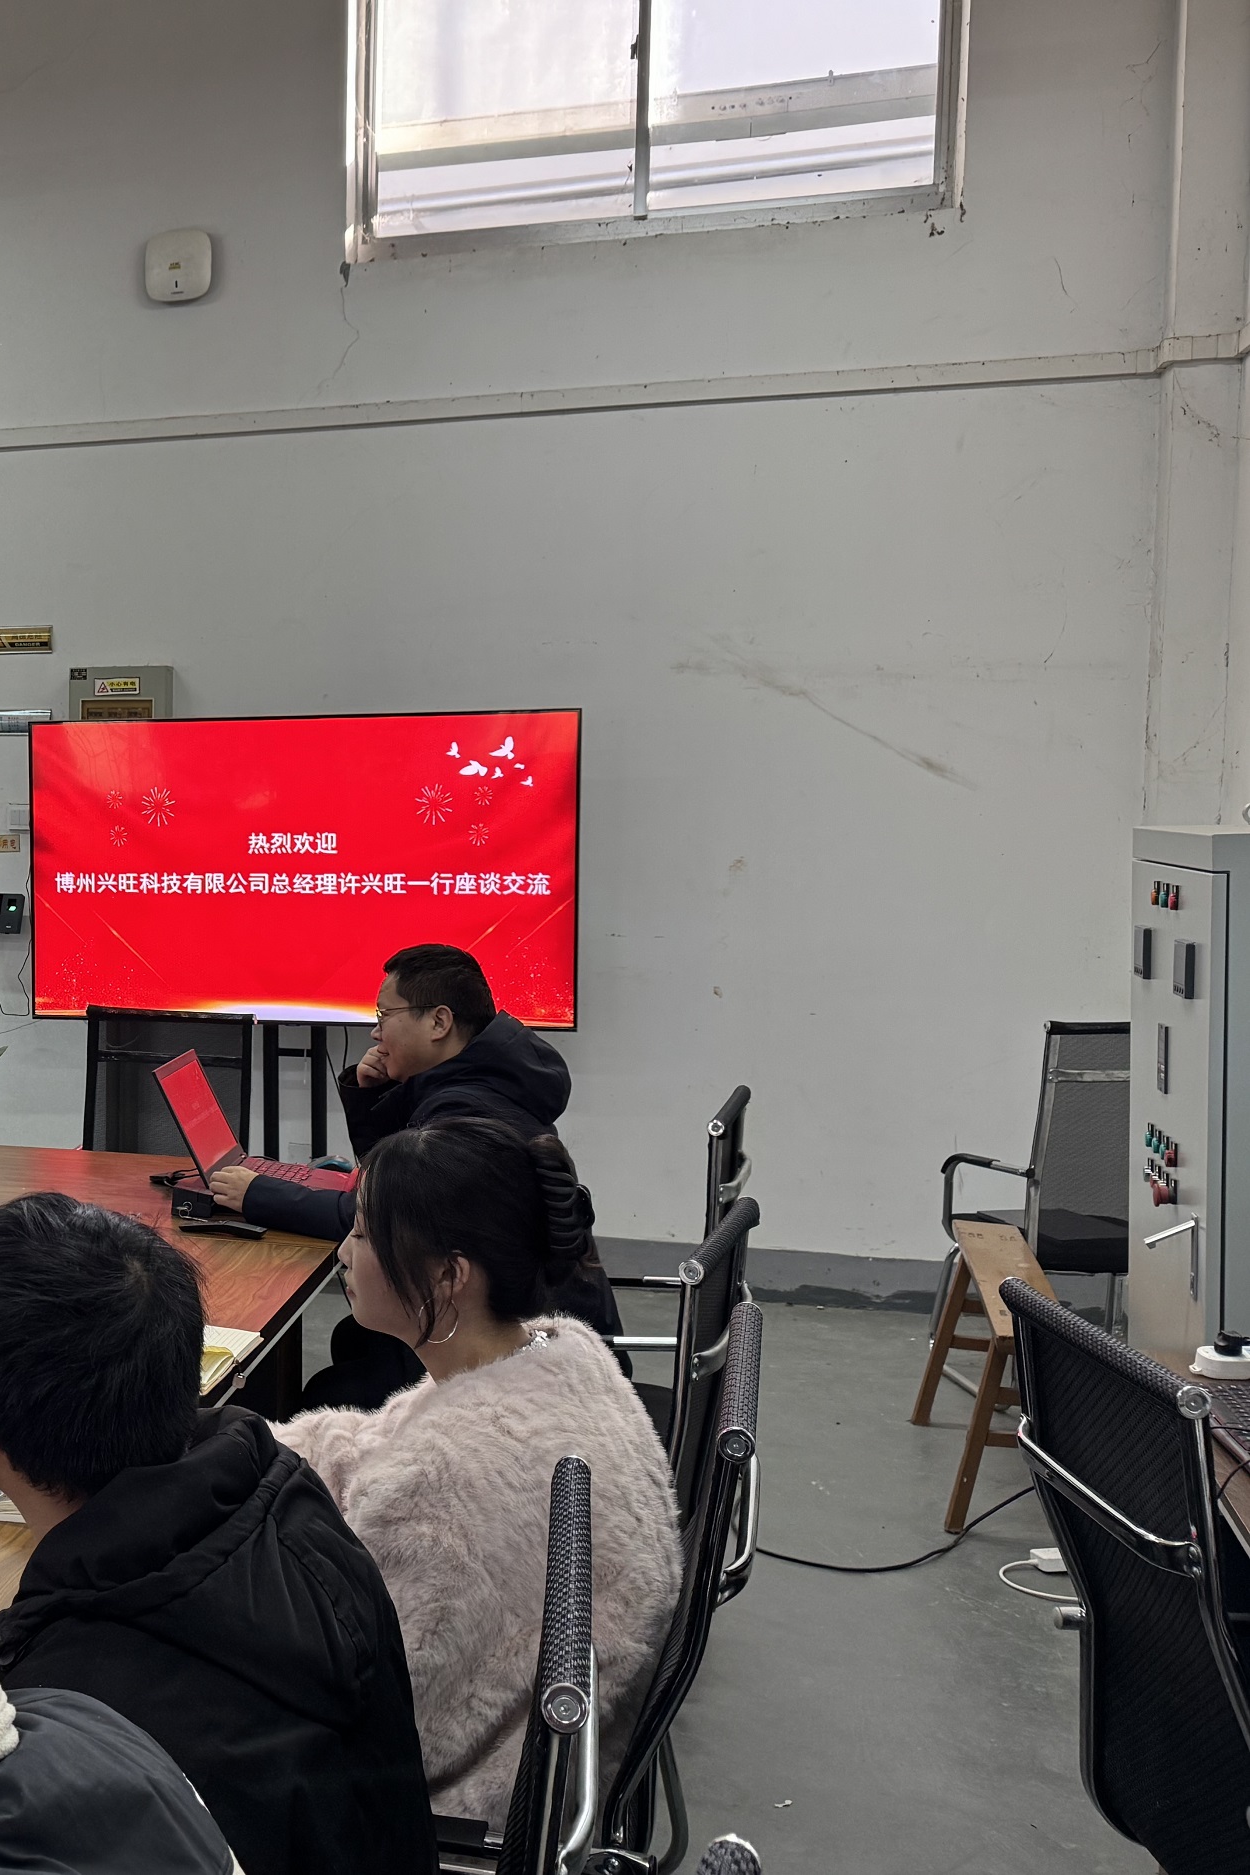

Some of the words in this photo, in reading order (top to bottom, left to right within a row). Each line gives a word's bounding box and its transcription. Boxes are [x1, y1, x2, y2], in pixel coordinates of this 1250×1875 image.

[248, 832, 339, 855] 热烈欢迎
[54, 871, 552, 896] 博州兴旺科技有限公司总经理许兴旺一行座谈交流
